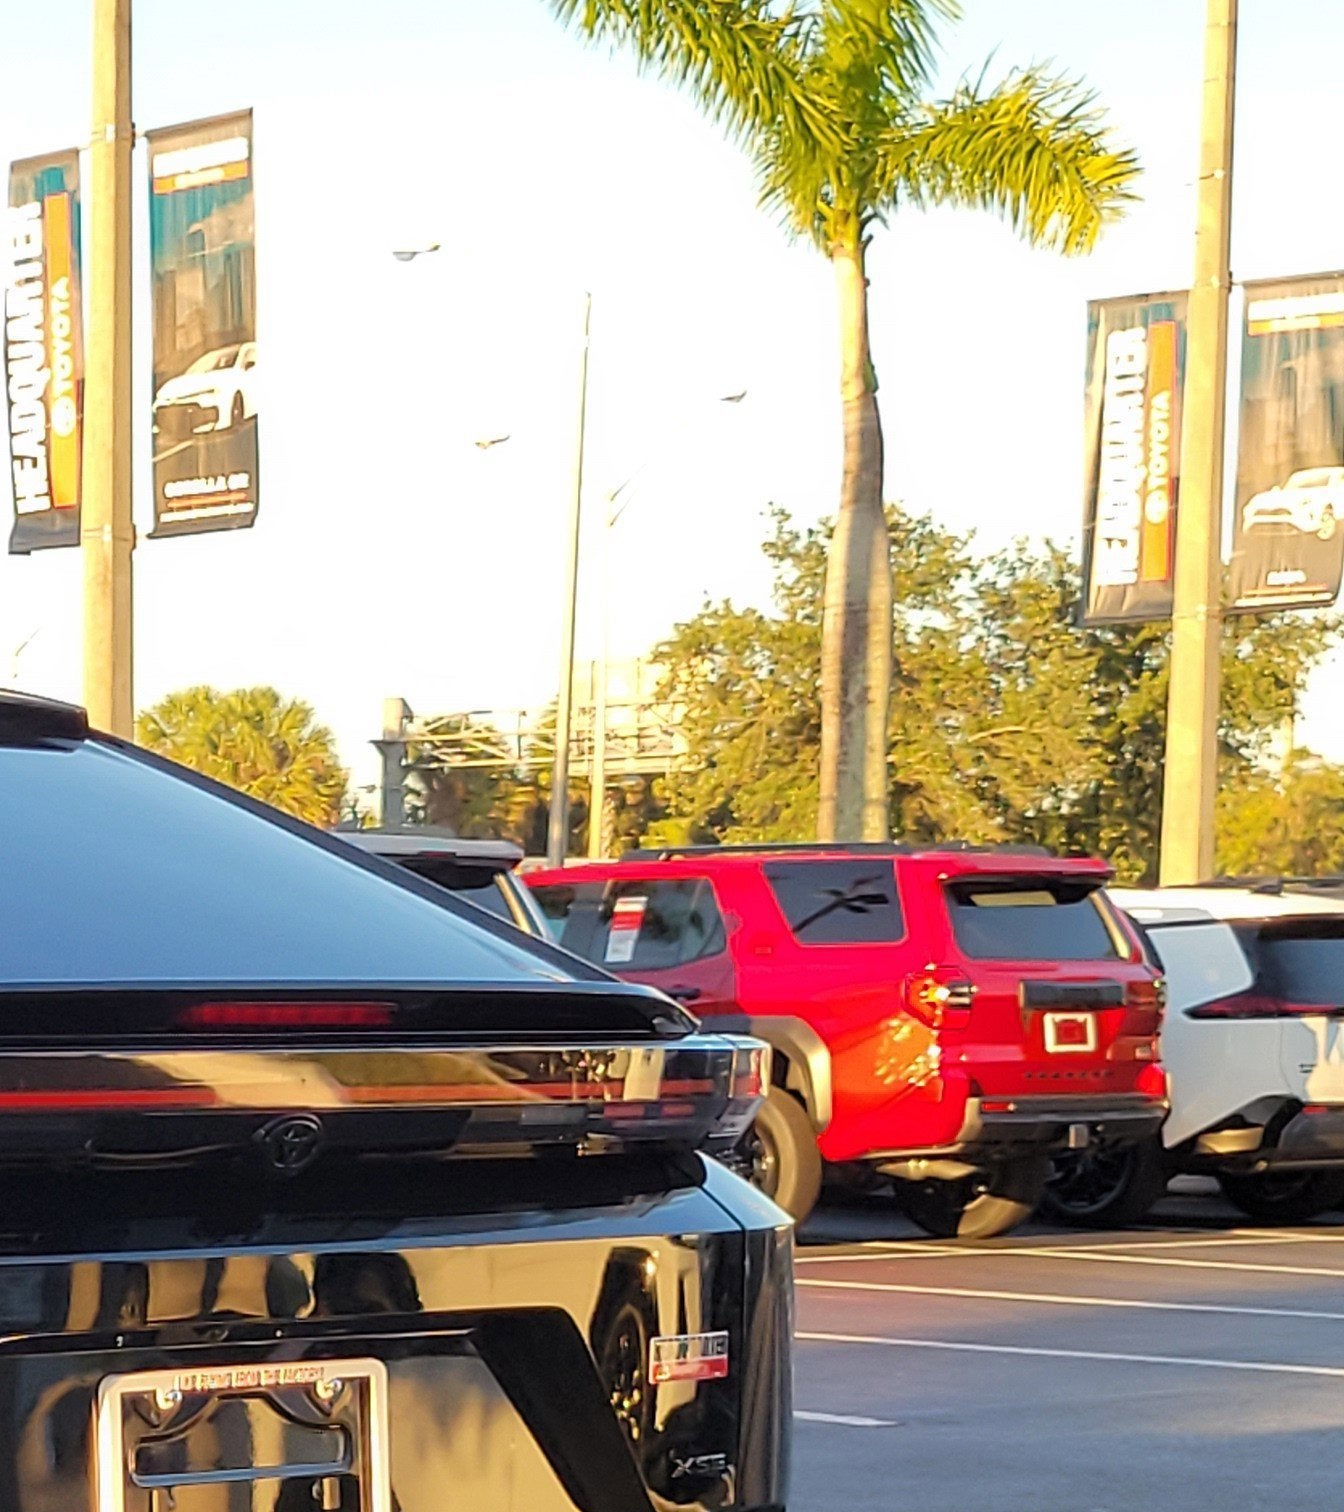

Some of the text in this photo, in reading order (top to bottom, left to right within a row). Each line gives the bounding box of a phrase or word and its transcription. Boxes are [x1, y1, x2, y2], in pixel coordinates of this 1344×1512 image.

[6, 200, 52, 515] HEADQUARTER
[51, 277, 75, 392] TOYOTA
[1149, 391, 1171, 489] TOYOTA
